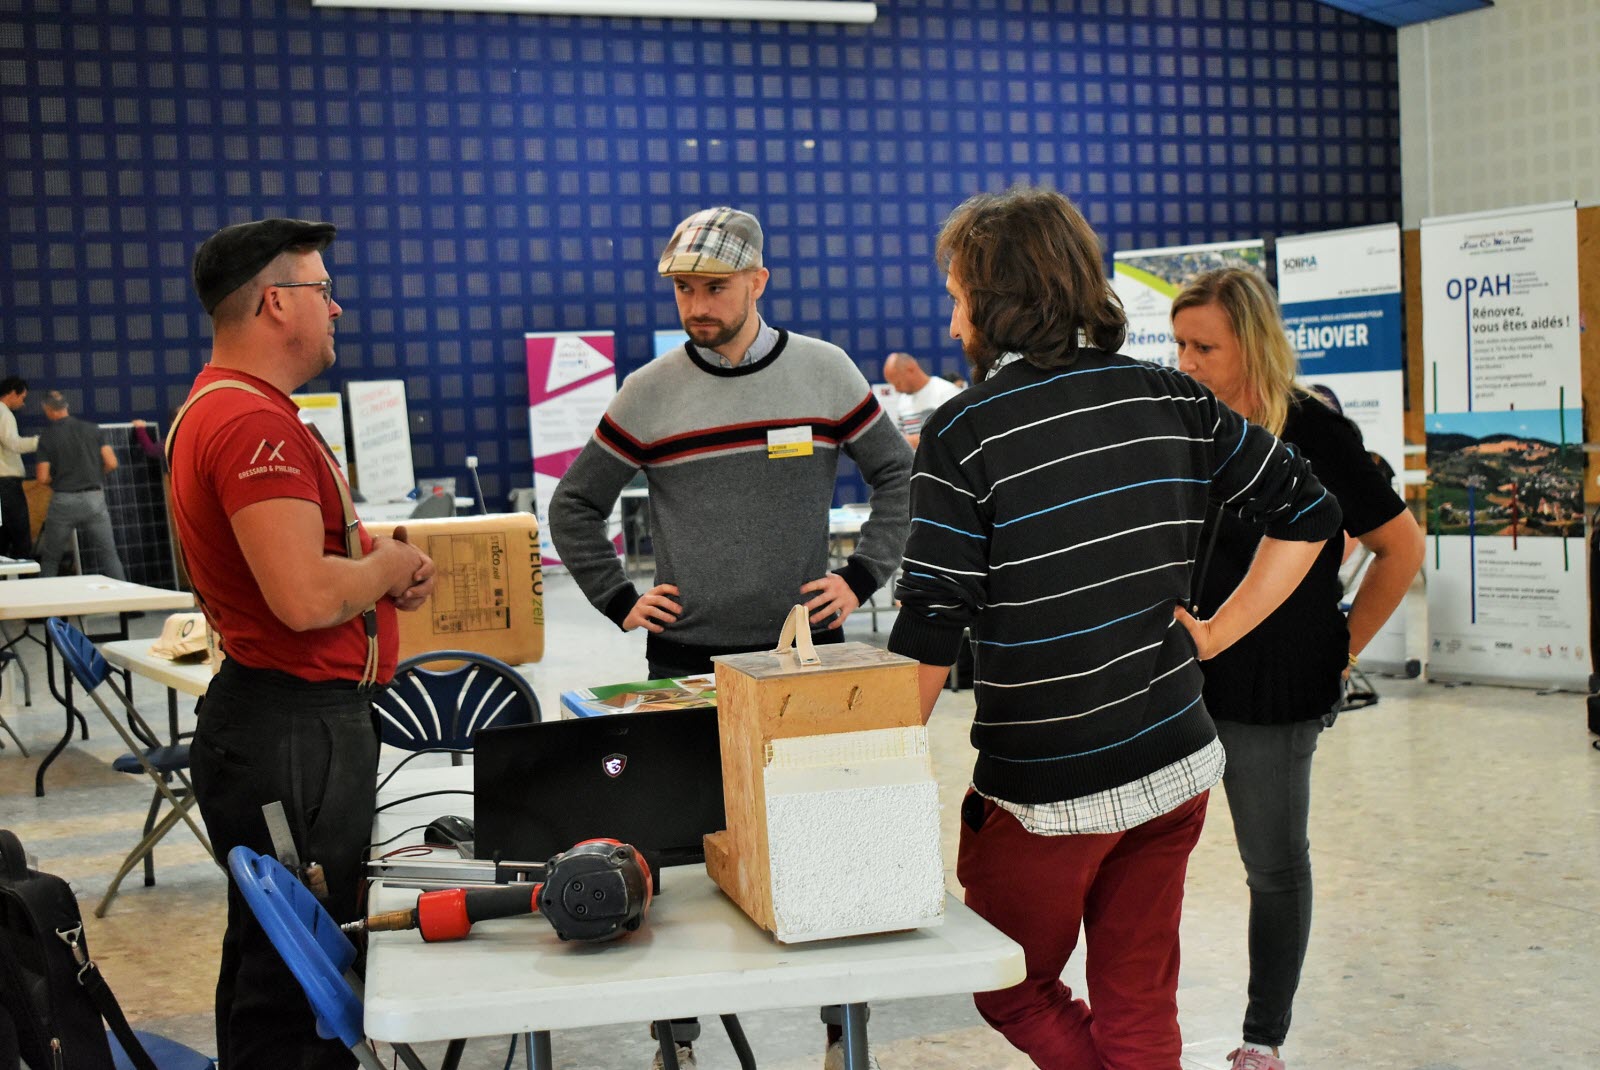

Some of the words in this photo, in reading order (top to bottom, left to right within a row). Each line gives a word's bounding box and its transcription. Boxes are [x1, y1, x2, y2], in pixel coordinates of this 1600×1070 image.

[1446, 273, 1511, 299] OPAH
[1472, 306, 1524, 320] Rénovez,
[1472, 322, 1500, 334] vous
[1502, 319, 1528, 332] êtes
[1531, 315, 1563, 330] aidés
[1566, 315, 1570, 328] !
[1283, 322, 1369, 351] RÉNOVER
